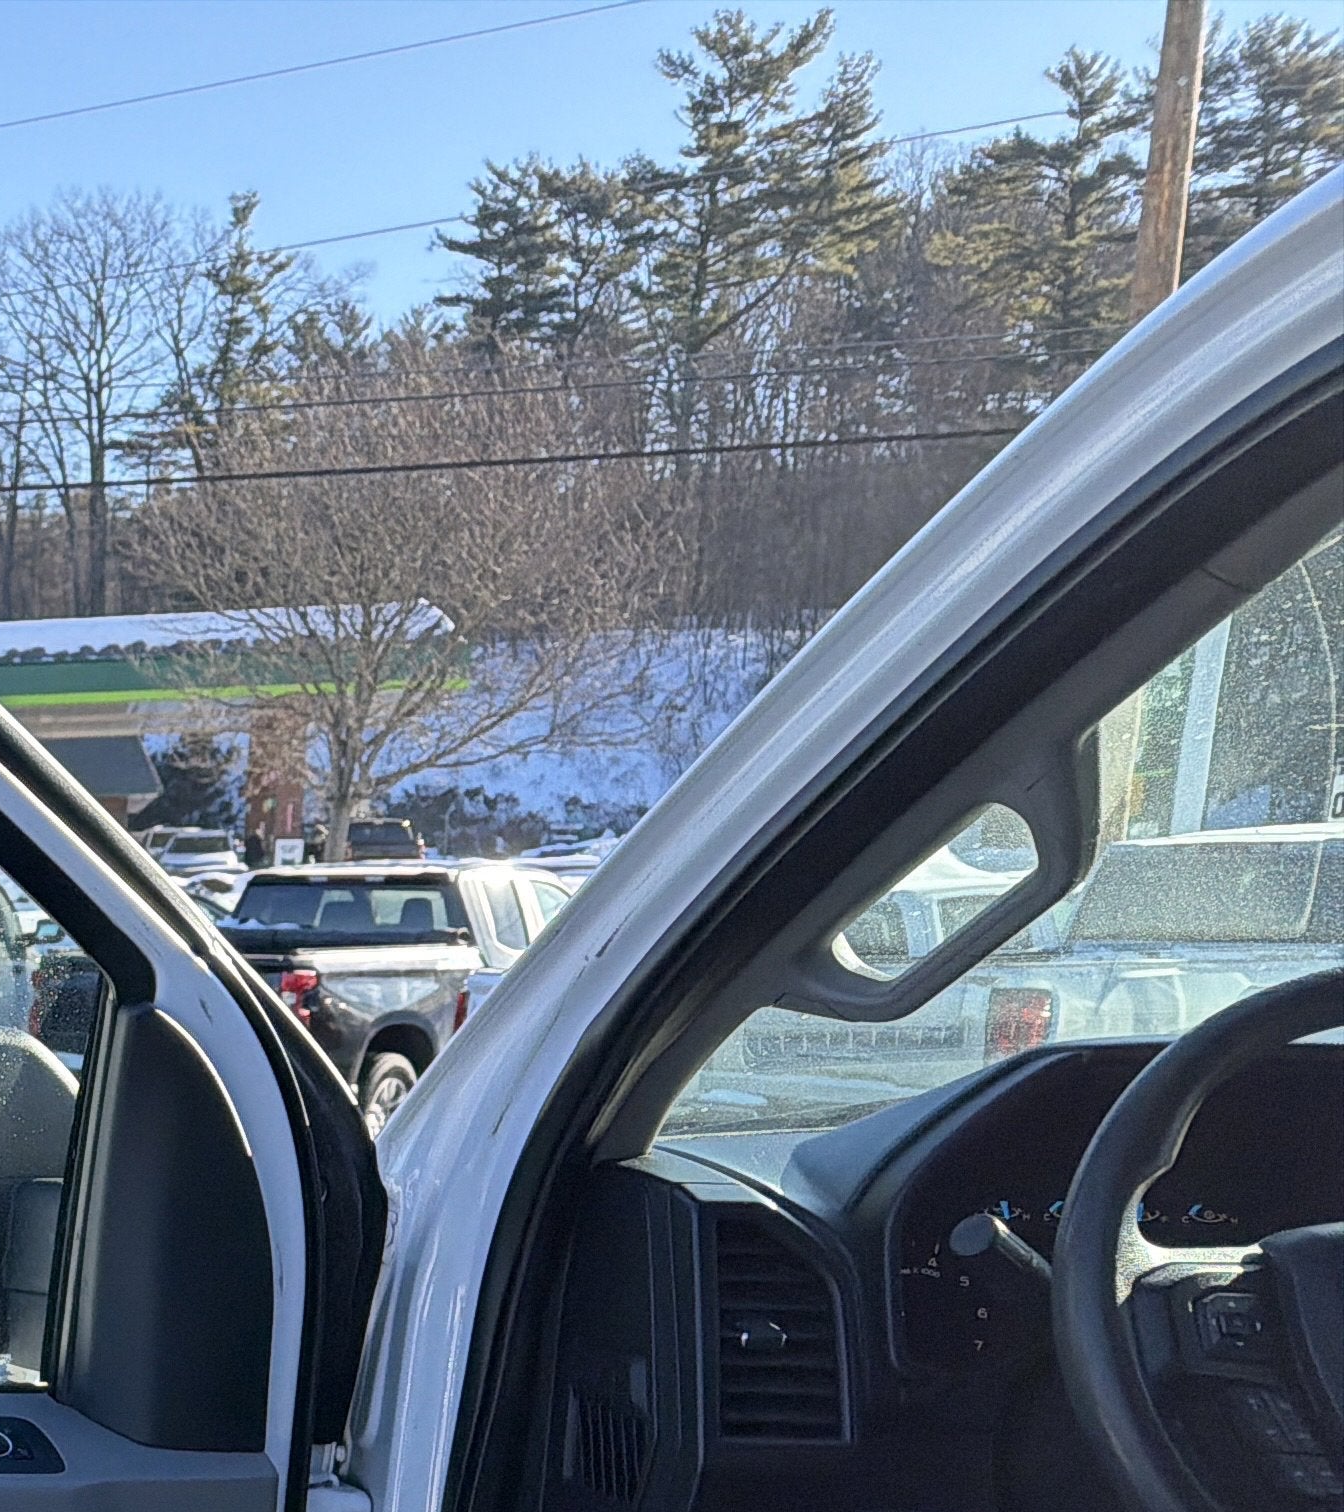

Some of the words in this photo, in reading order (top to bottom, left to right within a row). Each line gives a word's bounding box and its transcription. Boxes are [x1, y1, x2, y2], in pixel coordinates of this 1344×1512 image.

[959, 1276, 970, 1287] 5
[977, 1307, 988, 1319] 6
[974, 1340, 984, 1351] 7
